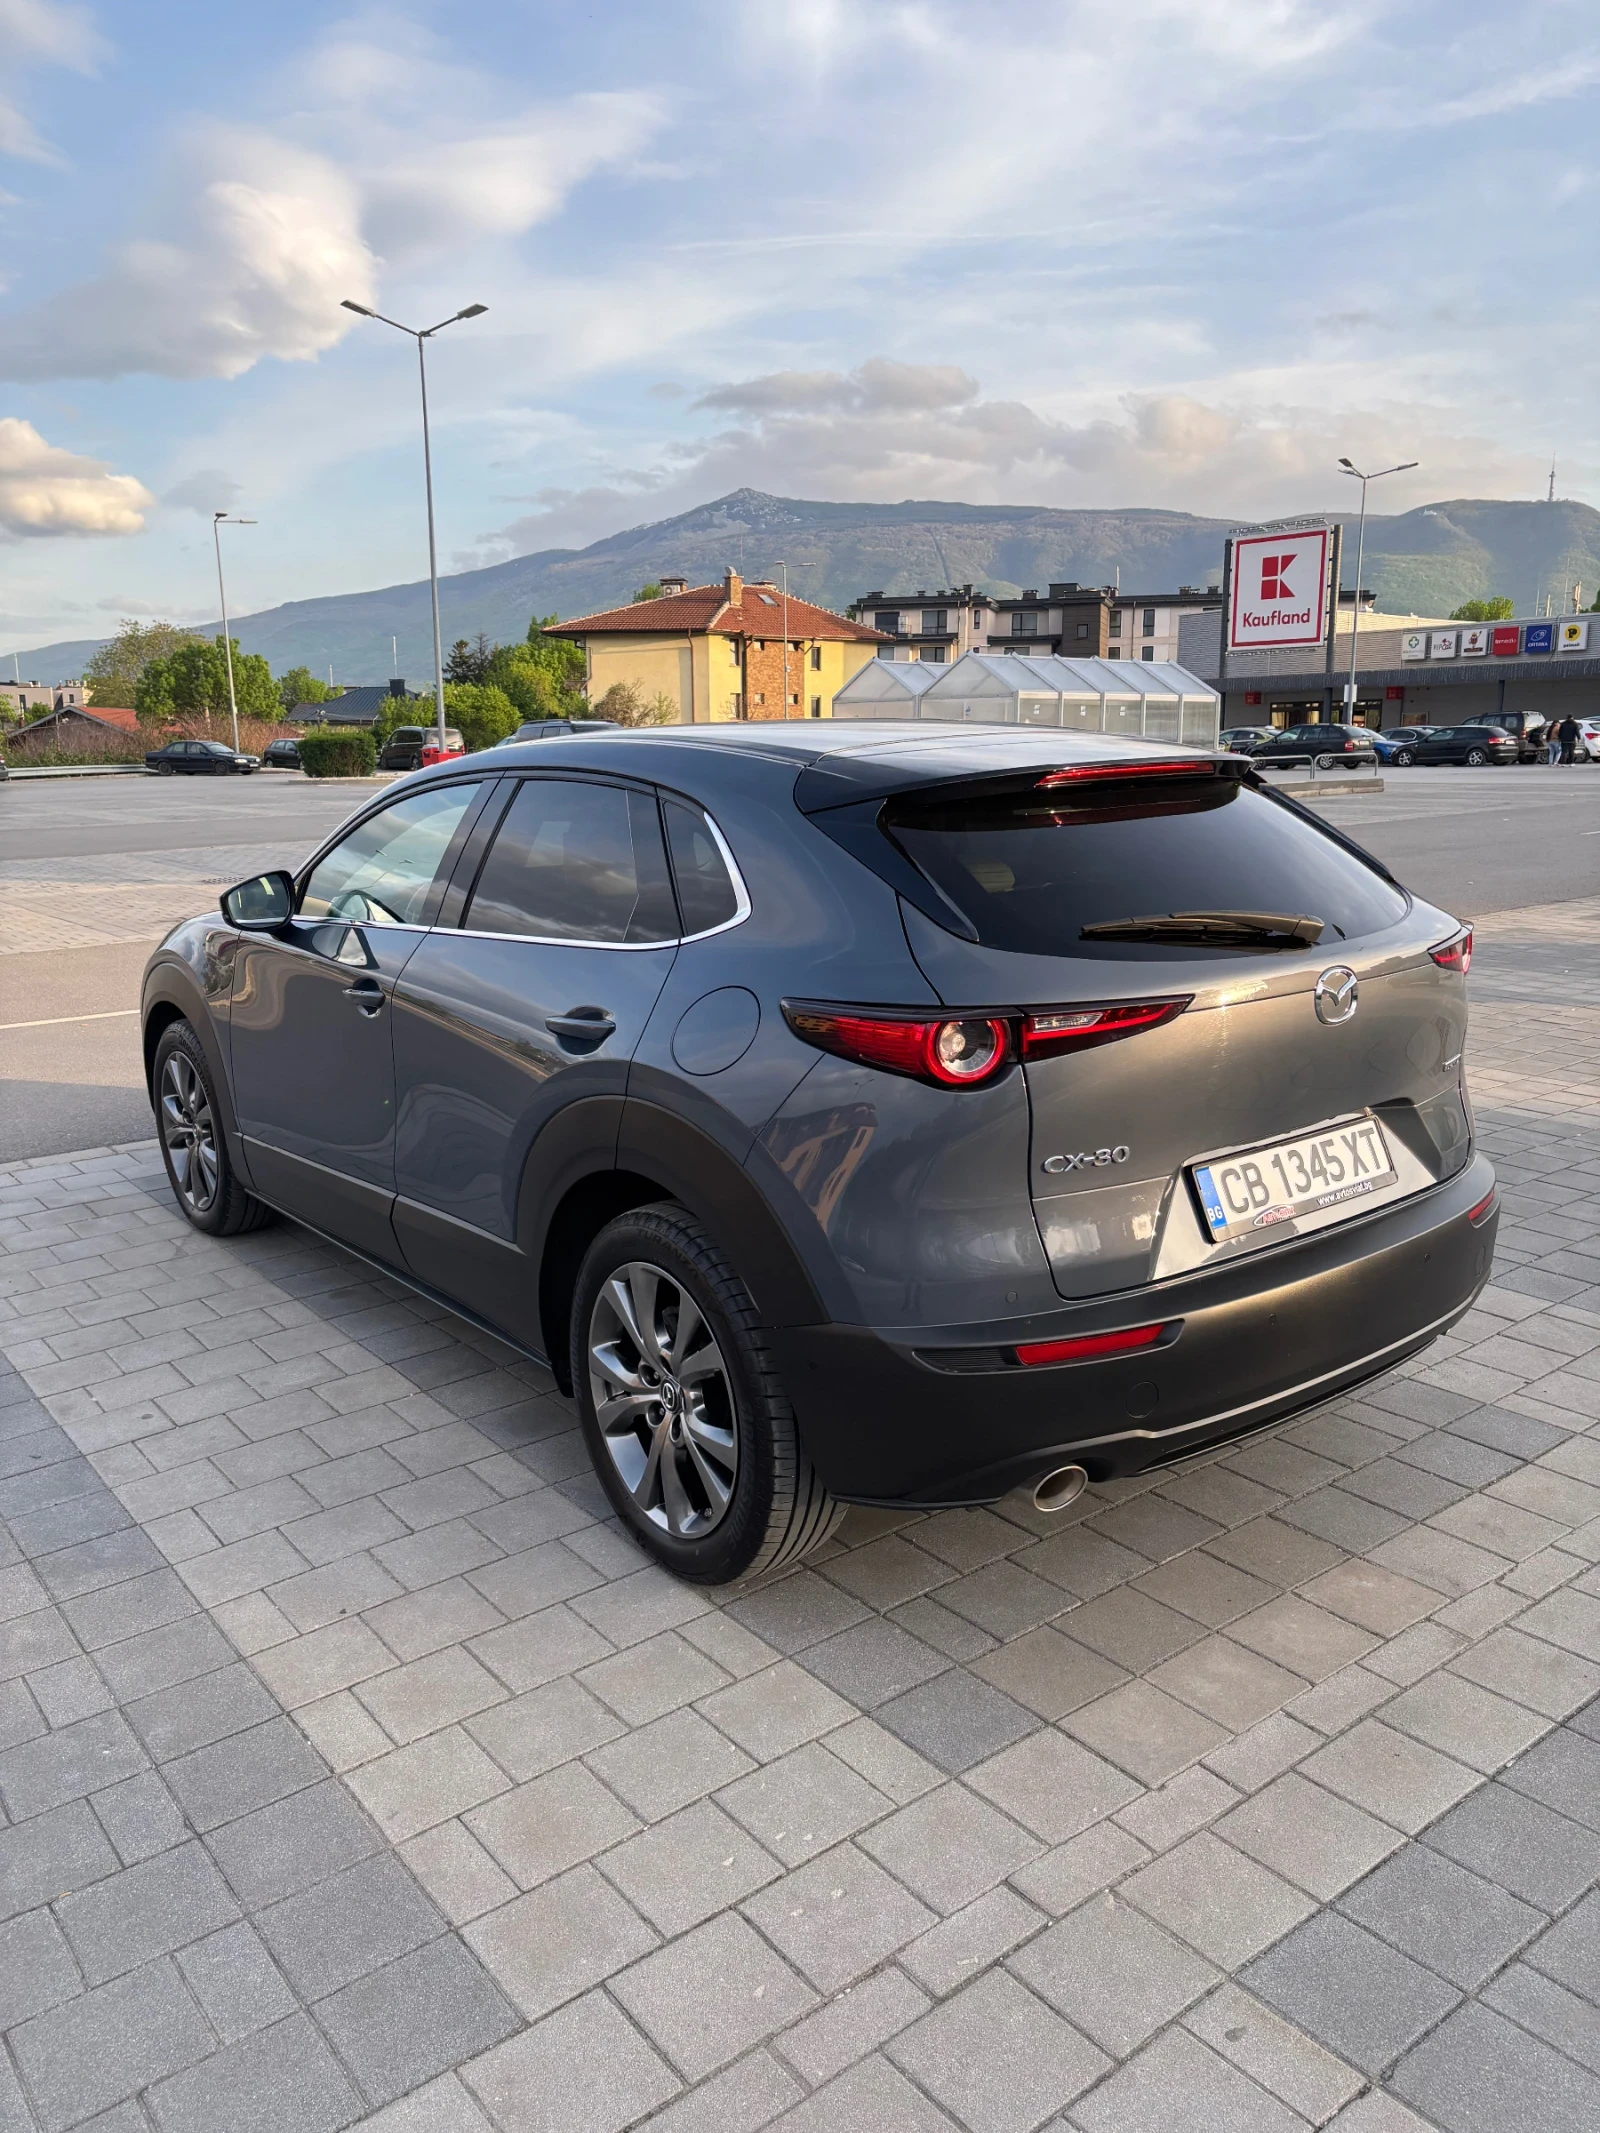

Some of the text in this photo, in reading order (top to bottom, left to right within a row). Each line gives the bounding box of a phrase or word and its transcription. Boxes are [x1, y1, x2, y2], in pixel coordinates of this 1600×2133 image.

[1261, 553, 1298, 600] K
[1242, 608, 1311, 627] Kaufland
[1043, 1145, 1130, 1174] CX-30
[1220, 1128, 1381, 1214] CB 1345 XT
[1207, 1205, 1225, 1222] BG
